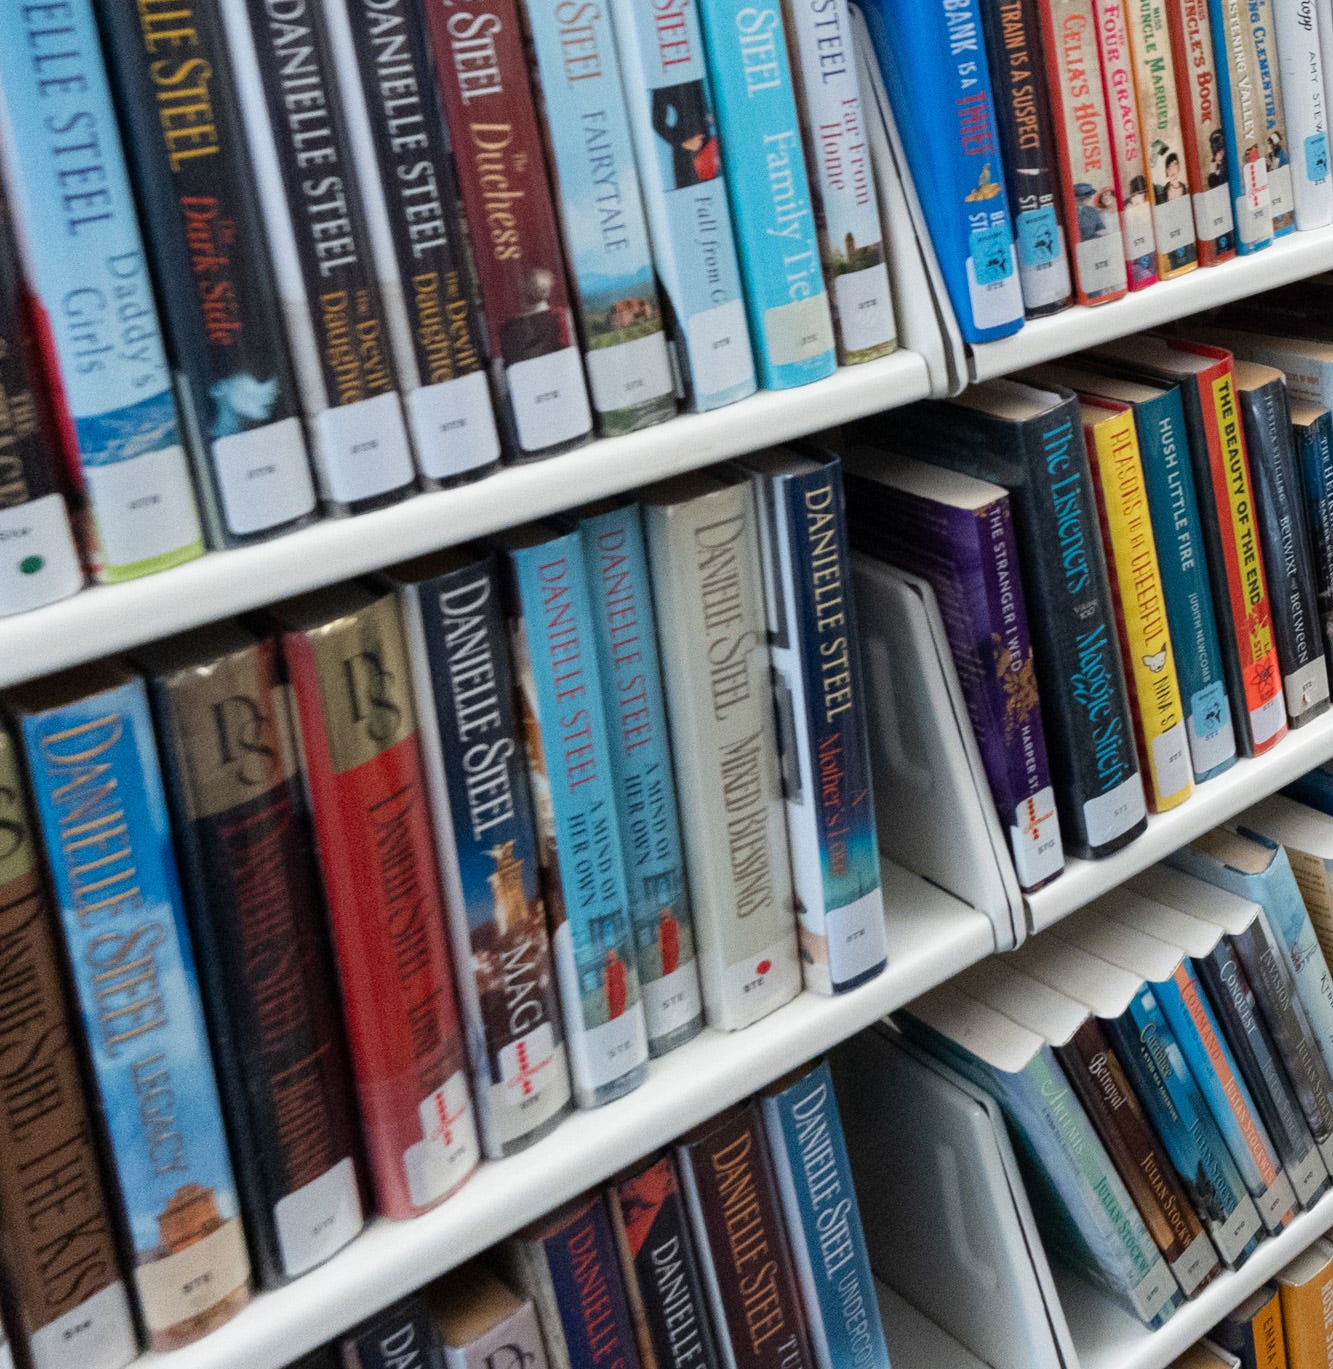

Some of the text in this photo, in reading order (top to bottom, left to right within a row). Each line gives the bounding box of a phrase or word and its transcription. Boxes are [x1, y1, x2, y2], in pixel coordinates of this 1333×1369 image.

[150, 56, 220, 175] STEEL
[446, 6, 499, 107] STEEL
[734, 0, 782, 99] STEEL
[1012, 81, 1040, 151] SUSPECT
[1061, 14, 1103, 173] CELIA'S HOUSE
[1104, 4, 1139, 162] FOUR GRACES
[46, 106, 116, 239] STEEL
[580, 108, 631, 256] FAIRYTALE
[762, 128, 815, 252] Family
[817, 122, 845, 192] Home
[841, 136, 870, 207] From
[954, 91, 996, 157] THIEF
[302, 172, 359, 280] STEEL
[398, 159, 448, 261] STEEL
[470, 121, 524, 261] Duchess
[693, 195, 714, 247] Fall
[63, 285, 108, 378] Girls
[106, 251, 164, 391] Daddy's
[198, 275, 235, 348] Side
[1042, 421, 1092, 598] The Listeners
[1158, 417, 1195, 573] HUSH LITTLE FIRE
[1224, 418, 1245, 496] BEAUTY
[803, 484, 856, 723] DANIELLE STEEL
[992, 546, 1016, 622] STRANGER
[1109, 426, 1164, 648] REASONS CHEERFUL
[438, 573, 517, 845] DANIELLE STEEL
[535, 555, 601, 796] DANIELLE STEEL
[596, 528, 654, 759] DANIELLE STEEL
[39, 713, 191, 1178] DANIELLE STEEL LEGACY
[710, 1132, 785, 1352] DANIELLE STEEL
[792, 1084, 858, 1280] DANIELLE STEEL
